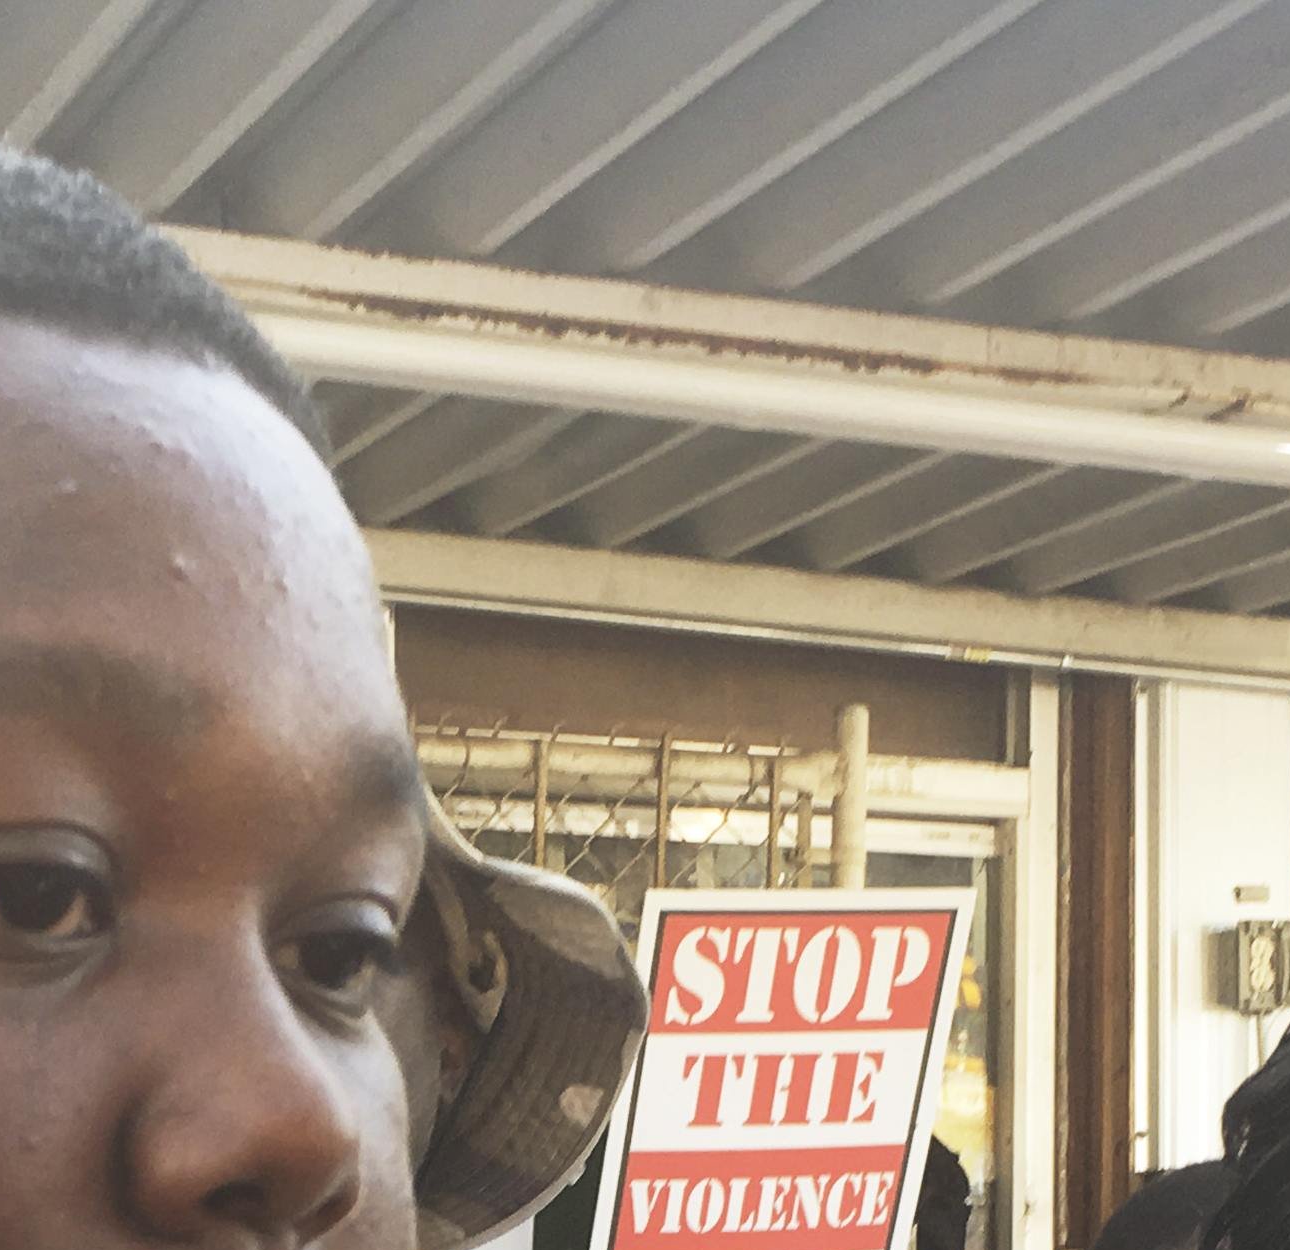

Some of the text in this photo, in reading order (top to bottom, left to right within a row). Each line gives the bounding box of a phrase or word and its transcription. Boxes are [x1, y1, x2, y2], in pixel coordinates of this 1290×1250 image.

[665, 926, 930, 1025] STOP
[683, 1053, 884, 1128] THE
[630, 1172, 895, 1234] VIOLENCE
